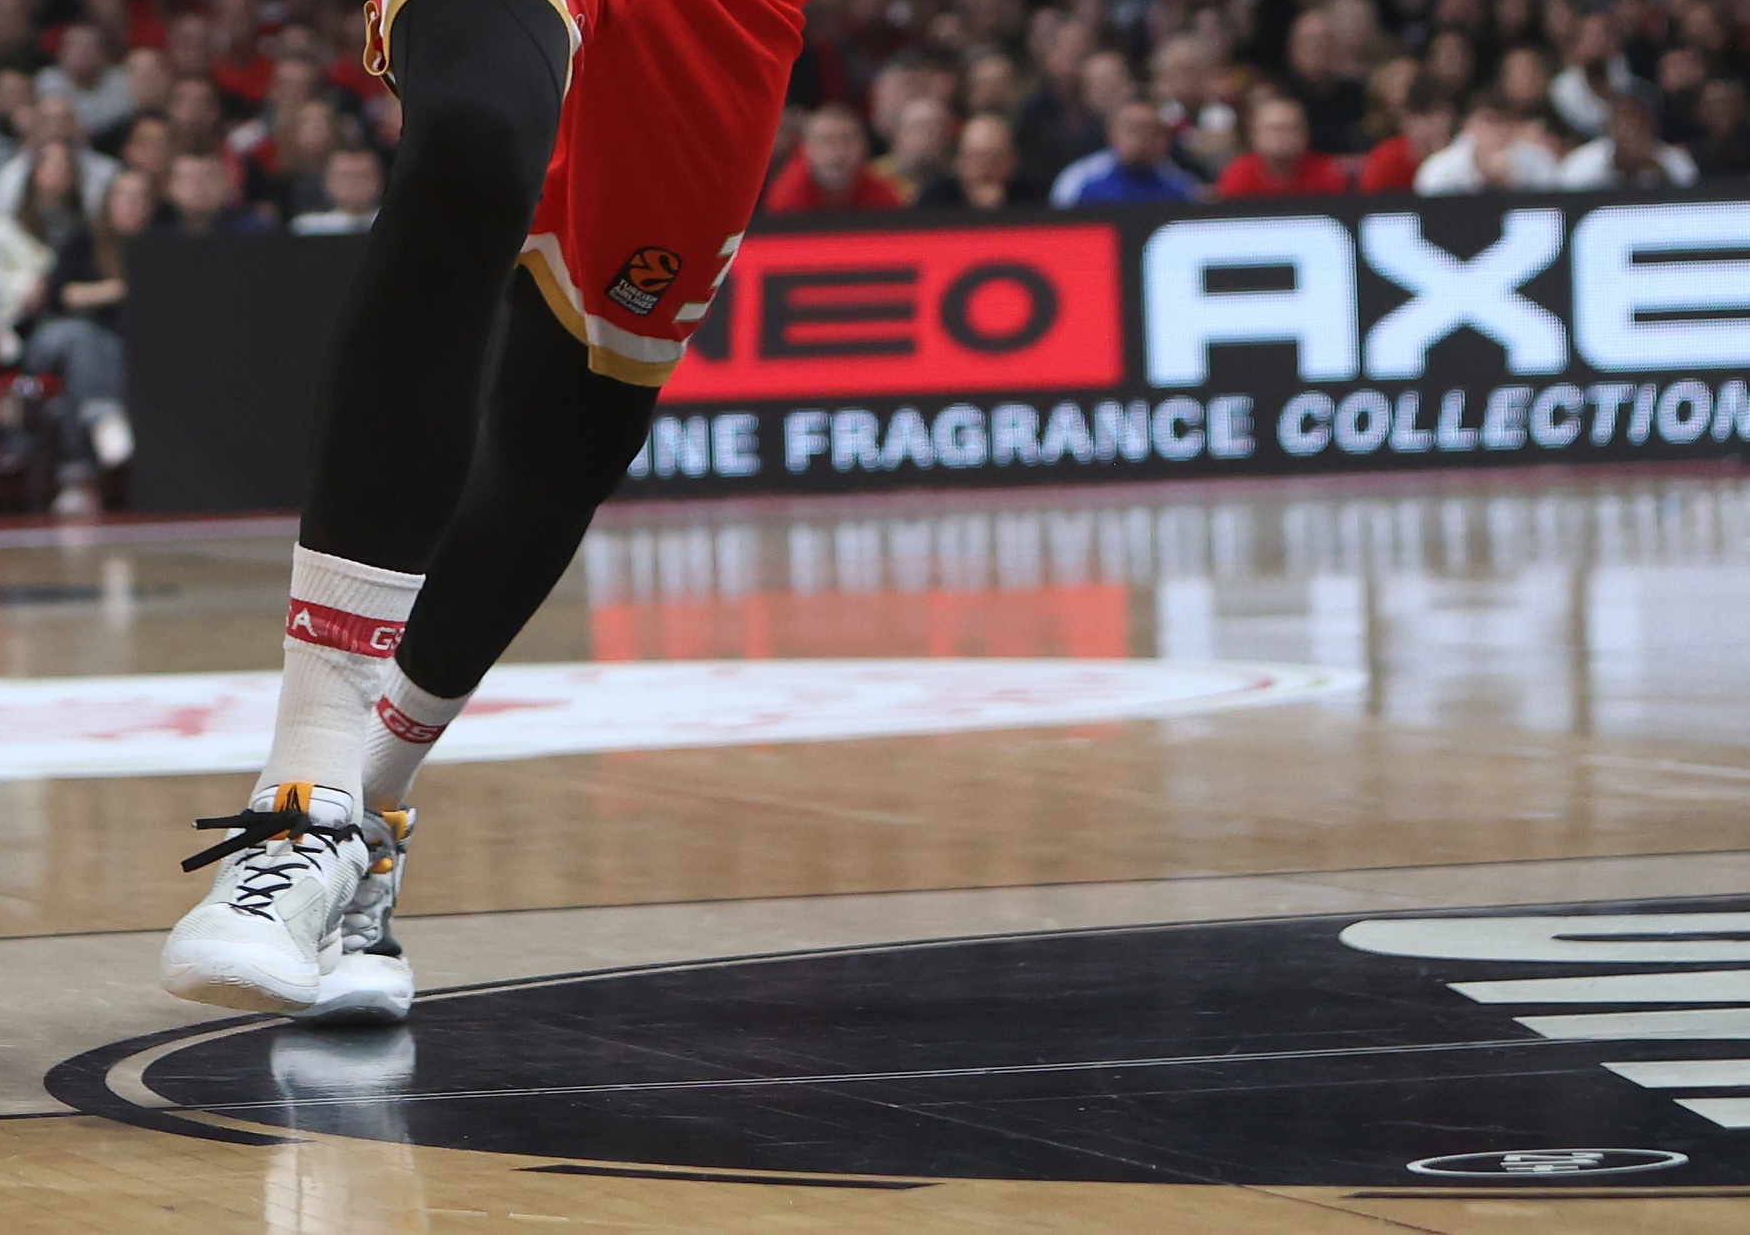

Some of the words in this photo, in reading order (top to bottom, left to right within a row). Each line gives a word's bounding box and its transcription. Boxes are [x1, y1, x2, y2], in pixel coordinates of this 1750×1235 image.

[1142, 201, 1750, 387] AXE
[783, 393, 1254, 473] FRAGRANCE
[1277, 377, 1750, 456] COLLECTION
